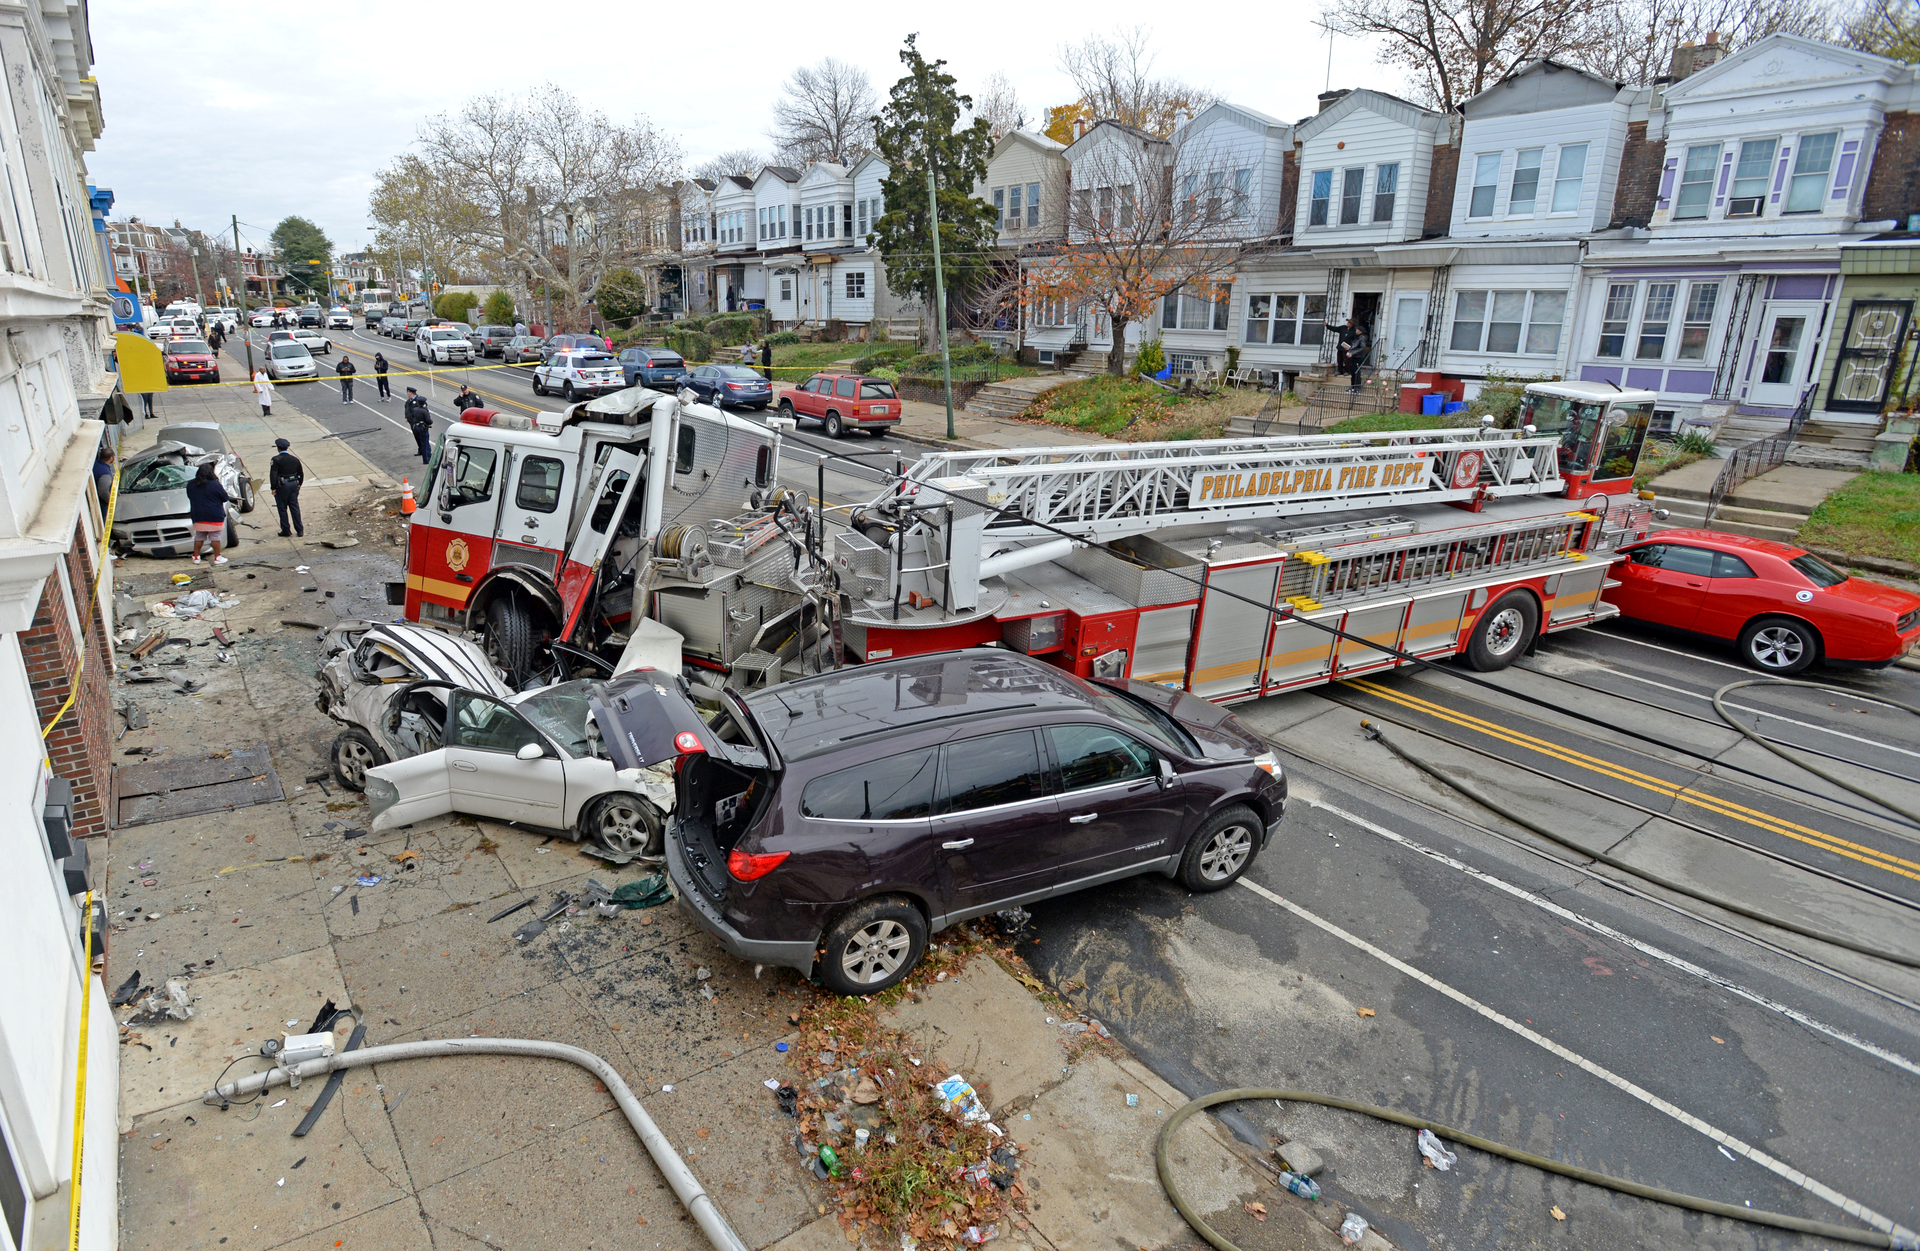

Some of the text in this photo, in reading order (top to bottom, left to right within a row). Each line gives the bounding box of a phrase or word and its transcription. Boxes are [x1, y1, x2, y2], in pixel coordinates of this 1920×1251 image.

[1201, 462, 1424, 500] PHILADELPHIA FIRE DEPT.
